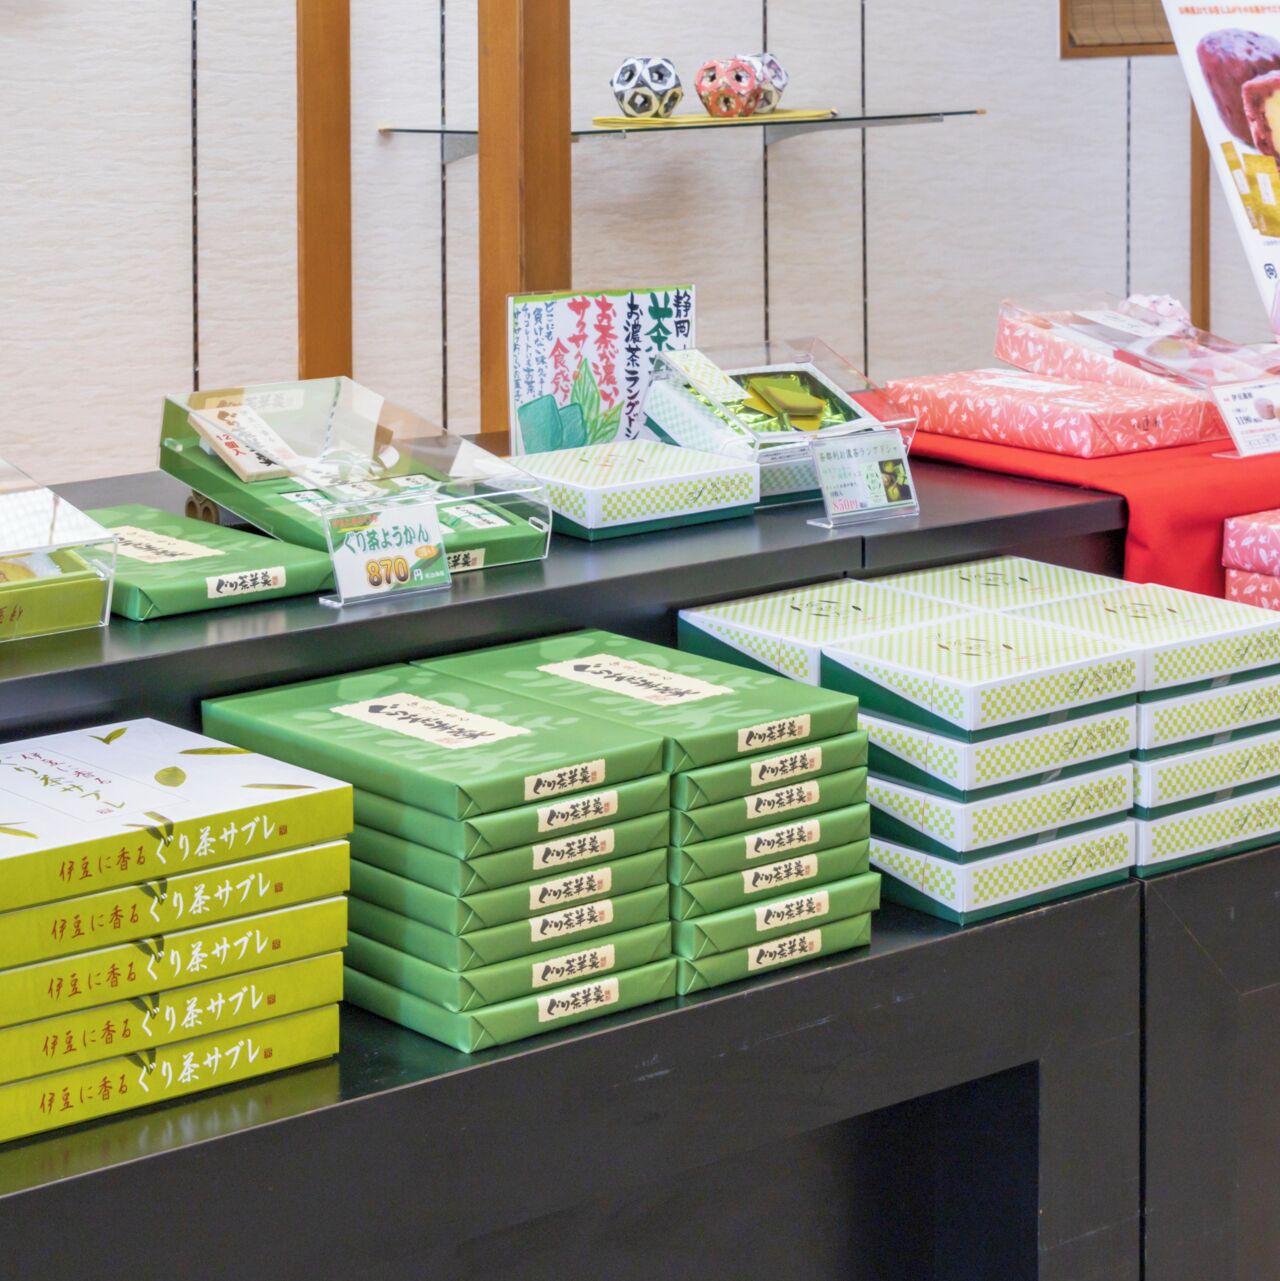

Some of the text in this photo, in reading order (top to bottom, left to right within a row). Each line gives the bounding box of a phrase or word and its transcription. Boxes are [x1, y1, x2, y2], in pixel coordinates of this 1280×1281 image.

[673, 288, 691, 350] 静岡
[594, 295, 619, 410] お茶が濃い
[344, 523, 429, 554] ぐり茶ようかん
[60, 816, 274, 879] 伊豆に香る ぐり茶サブレ
[52, 873, 269, 938] 伊豆に香る ぐり茶サブレ
[48, 931, 267, 995] 伊豆に香る ぐり茶サブレ
[44, 986, 262, 1055] 伊豆に香る ぐり茶サブレ
[40, 1040, 258, 1113] 伊豆に香る ぐり茶サブレ
